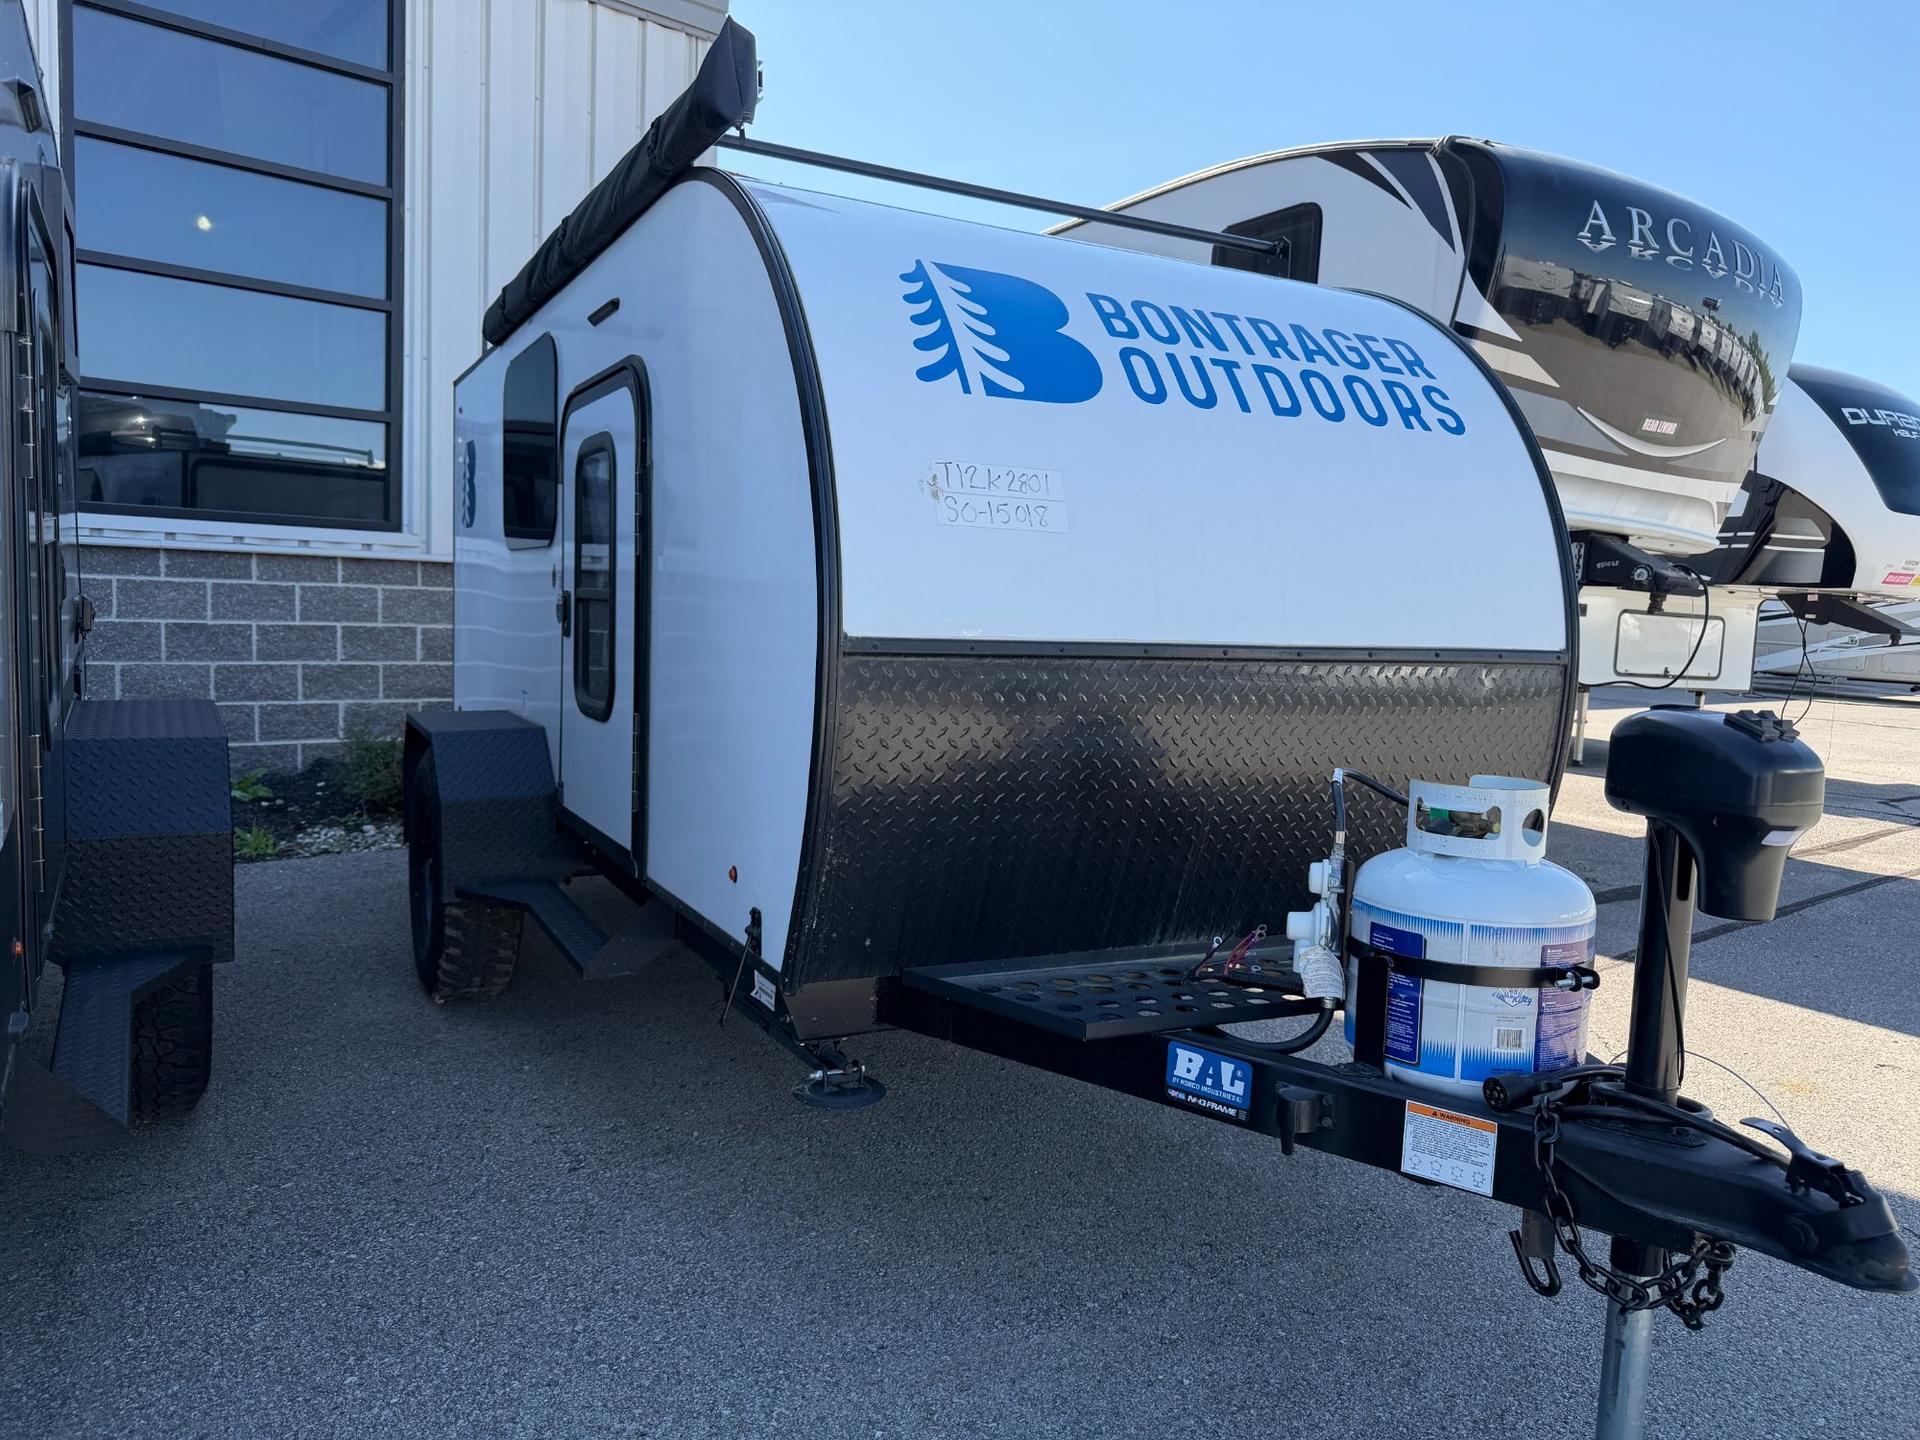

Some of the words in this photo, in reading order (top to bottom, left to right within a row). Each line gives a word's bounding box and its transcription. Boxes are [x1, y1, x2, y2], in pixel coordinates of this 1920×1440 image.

[1576, 199, 1785, 304] ARCADIA
[1086, 292, 1436, 379] BONTRAGER
[1118, 347, 1466, 436] OUTDOORS
[1173, 1047, 1245, 1096] BAL
[1201, 1085, 1236, 1101] INDUSTRIES
[1207, 1101, 1237, 1117] FRAME
[1440, 1111, 1471, 1125] WARNING
